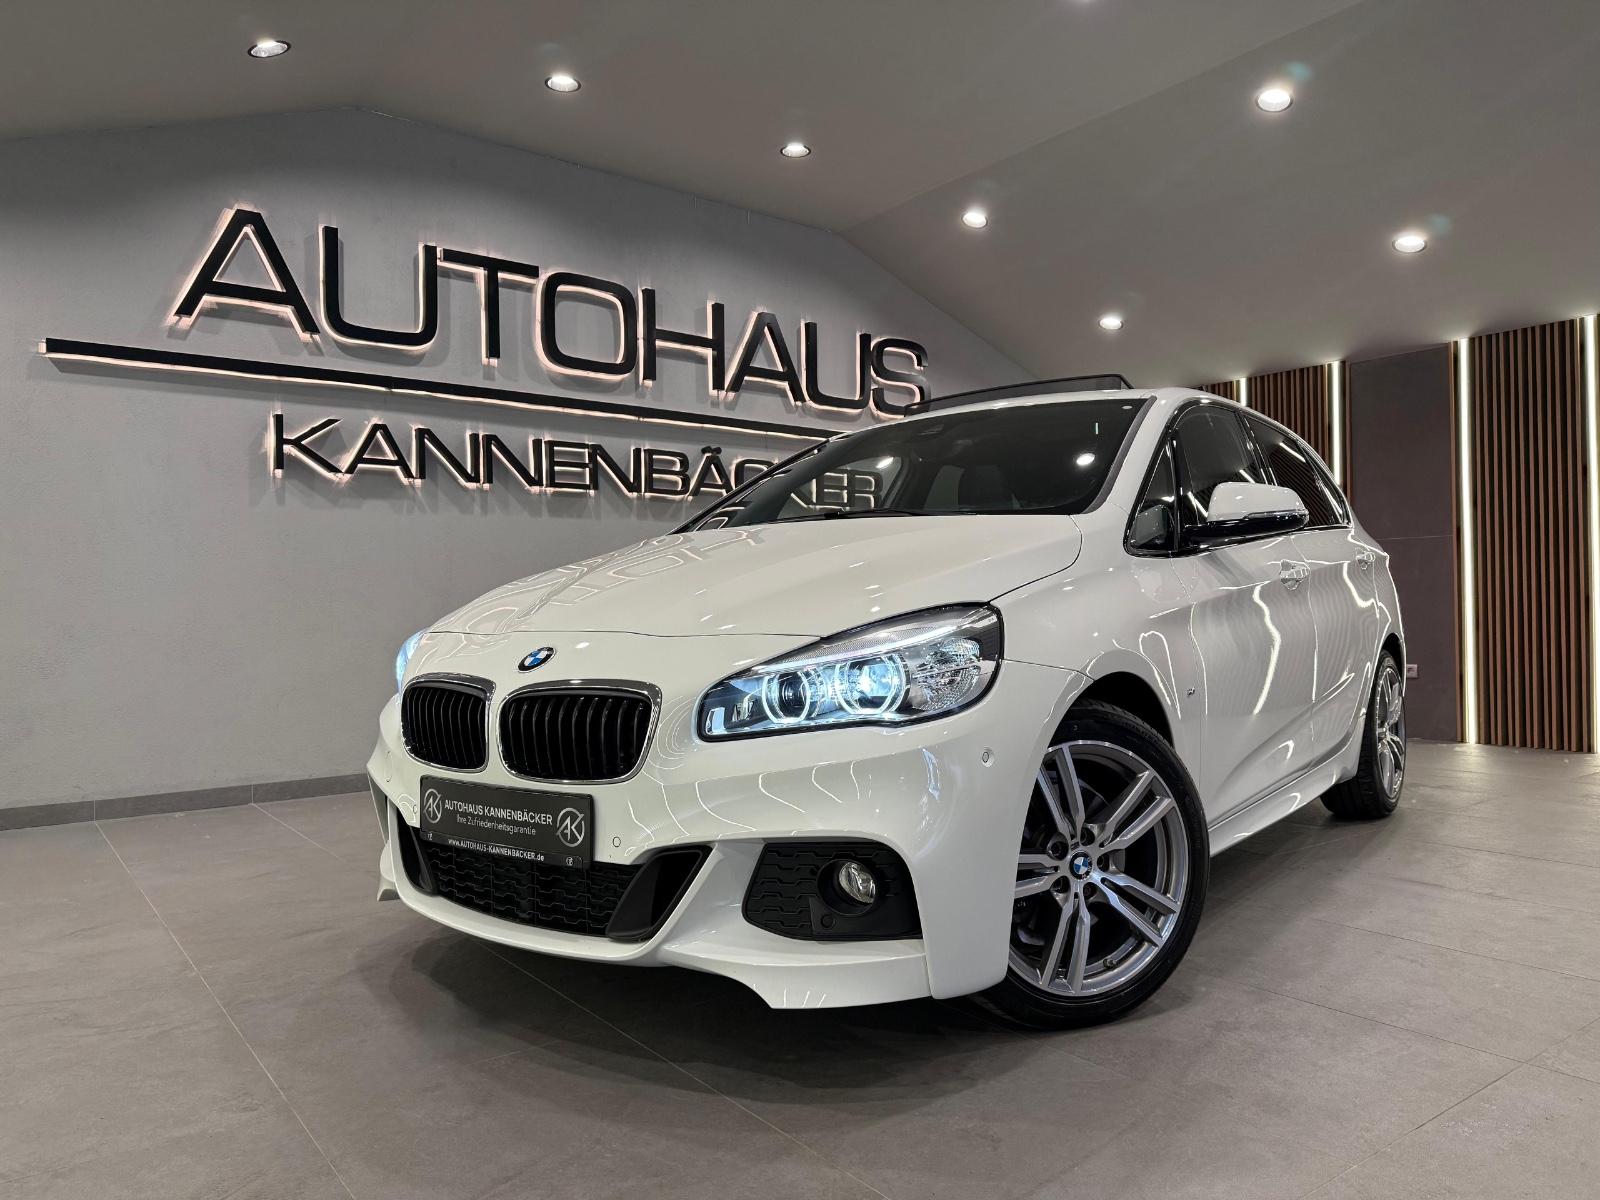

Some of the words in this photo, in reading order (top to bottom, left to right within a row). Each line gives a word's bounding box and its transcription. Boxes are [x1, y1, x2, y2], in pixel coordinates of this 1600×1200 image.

[172, 206, 930, 416] AUTOHAUS
[273, 412, 884, 512] KANNENBÄCER
[444, 799, 484, 816] AUTOHAUS
[484, 805, 553, 826] KANNENBÄCKER
[456, 813, 467, 825] Ihre
[467, 815, 536, 836] Zufriedenheitsgarantie
